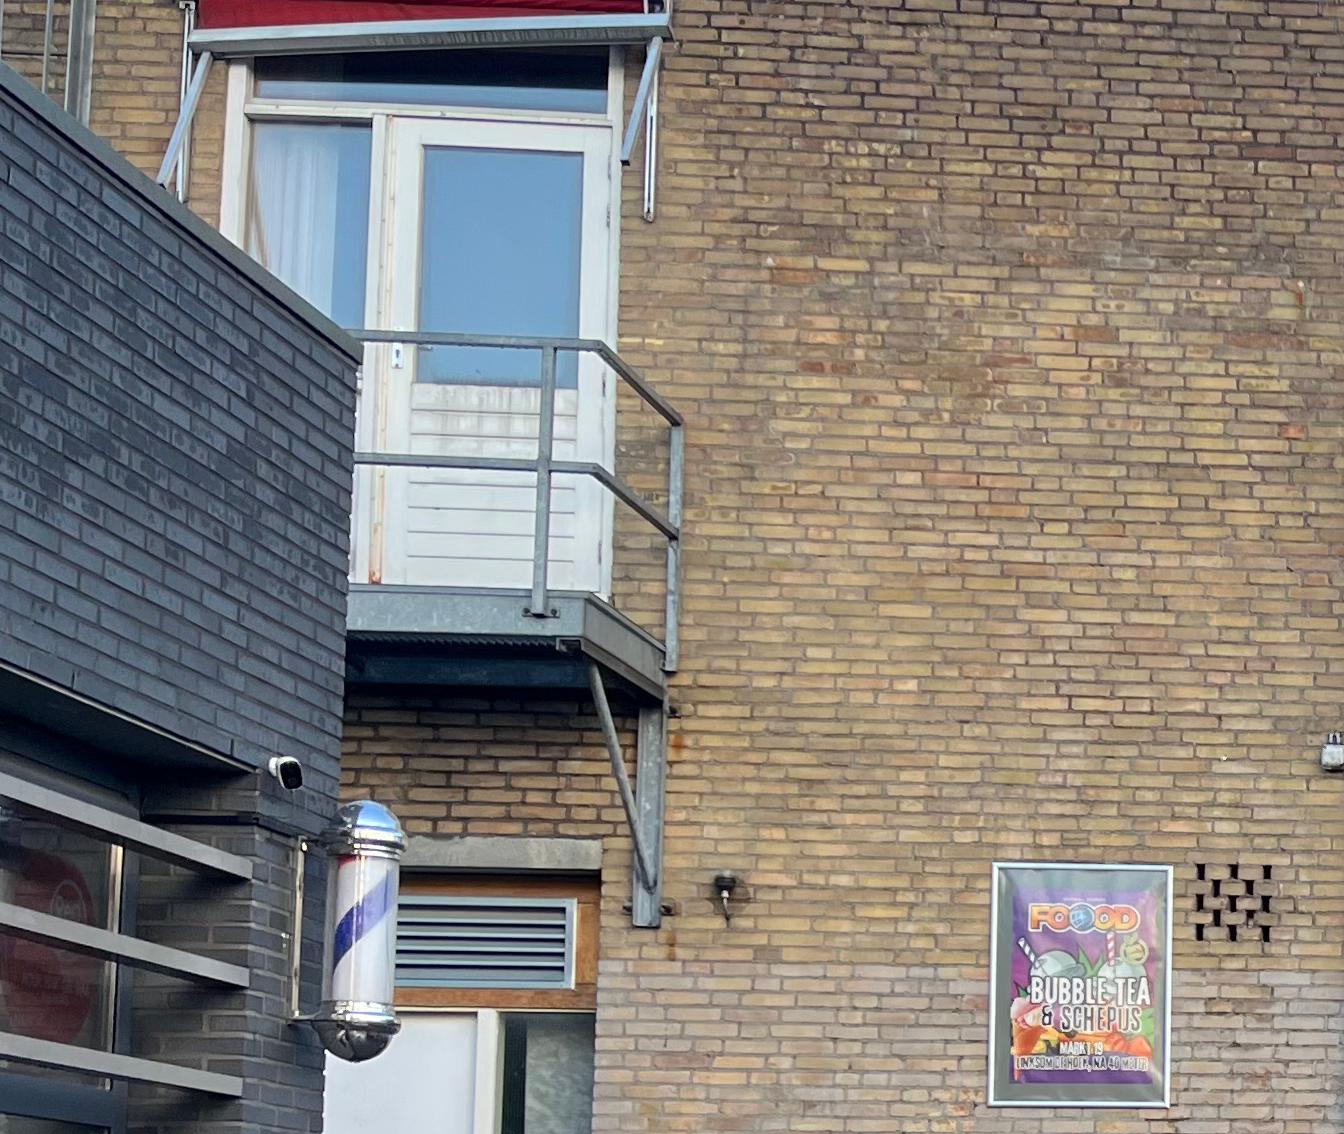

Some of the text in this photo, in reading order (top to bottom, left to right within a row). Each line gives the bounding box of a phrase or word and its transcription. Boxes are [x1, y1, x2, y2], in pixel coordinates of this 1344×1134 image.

[1031, 976, 1151, 1006] BUBBLE TEA
[1042, 1005, 1141, 1032] & SCHEPUS
